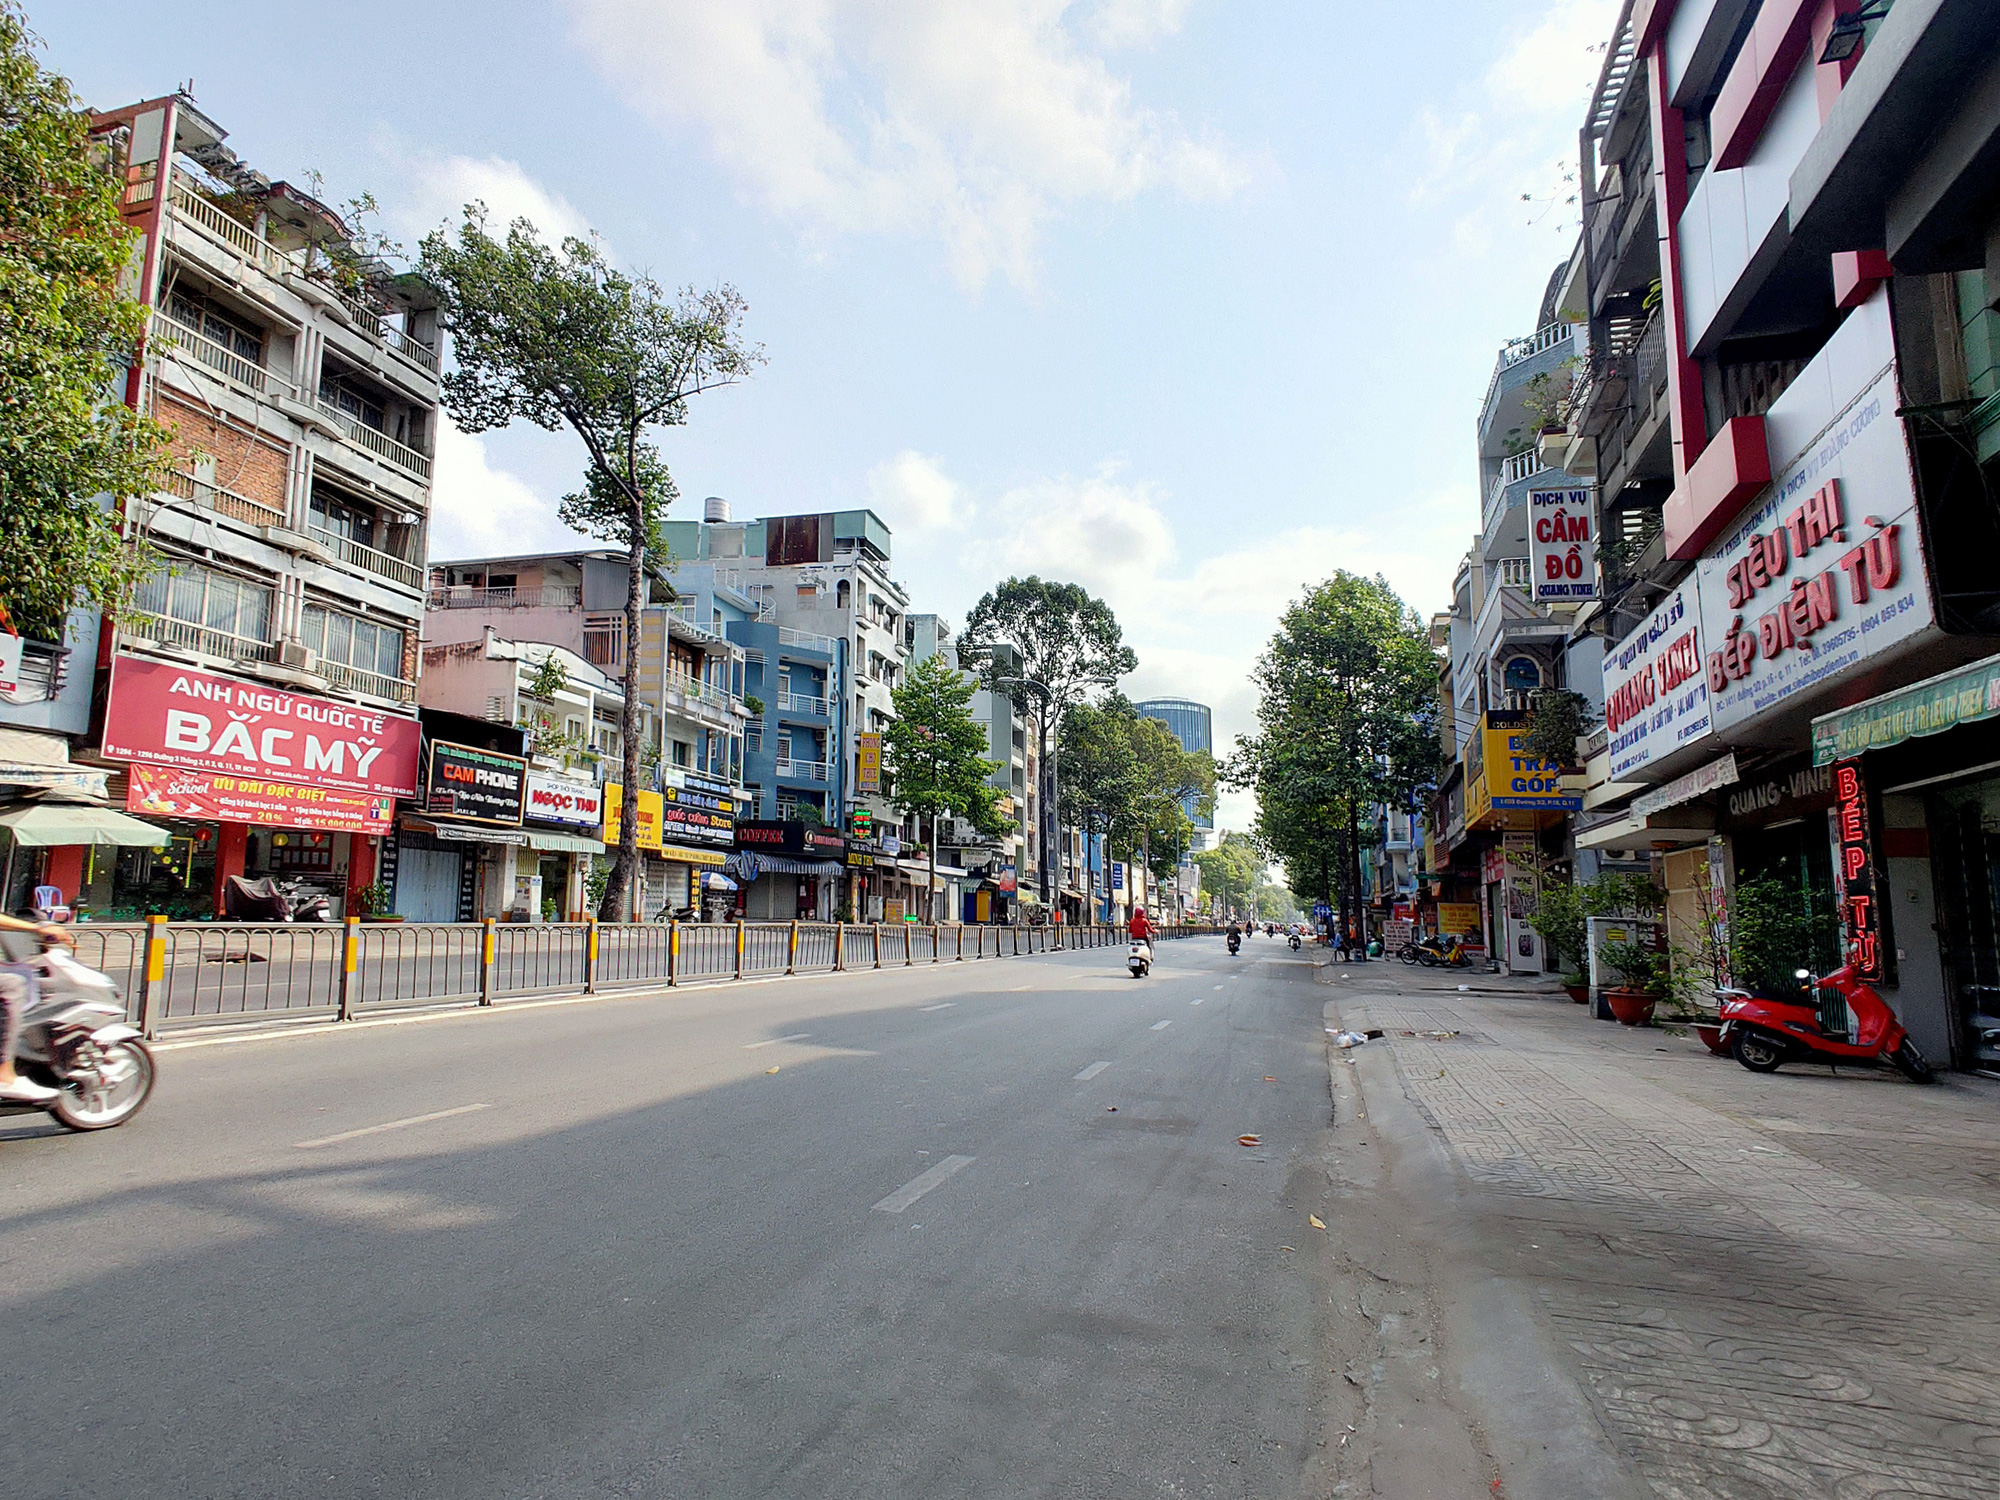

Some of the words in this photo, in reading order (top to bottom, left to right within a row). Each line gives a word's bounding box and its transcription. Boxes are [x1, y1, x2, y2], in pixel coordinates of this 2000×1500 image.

[1533, 492, 1564, 507] DỊCH
[1568, 490, 1587, 505] VỤ
[1536, 507, 1589, 543] CẦM
[1726, 526, 1789, 609] SIÊU
[1785, 478, 1845, 558] THỊ
[1545, 544, 1582, 580] ĐỒ
[1538, 585, 1569, 596] QUANG
[1570, 584, 1593, 595] VINH
[1707, 614, 1757, 693] BẾP
[1758, 571, 1839, 660] ĐIỆN
[1840, 515, 1901, 605] TỪ
[1897, 593, 1915, 613] 934
[1605, 663, 1655, 733] QUANG
[1655, 626, 1700, 697] VINH
[168, 676, 231, 704] ANH
[237, 690, 294, 715] NGỮ
[296, 705, 356, 730] QUỐC
[359, 715, 388, 735] TẾ
[1753, 691, 1778, 710] Website:
[164, 708, 295, 767] BẮC
[303, 734, 384, 779] MỸ
[167, 781, 210, 795] School
[443, 763, 475, 785] CAM
[475, 768, 518, 790] PHONE
[266, 784, 295, 799] ĐẶC
[297, 788, 327, 803] BIỆT
[531, 789, 573, 812] NGỌC
[575, 796, 597, 813] THU
[710, 815, 732, 829] Store
[737, 828, 784, 844] COFFEE
